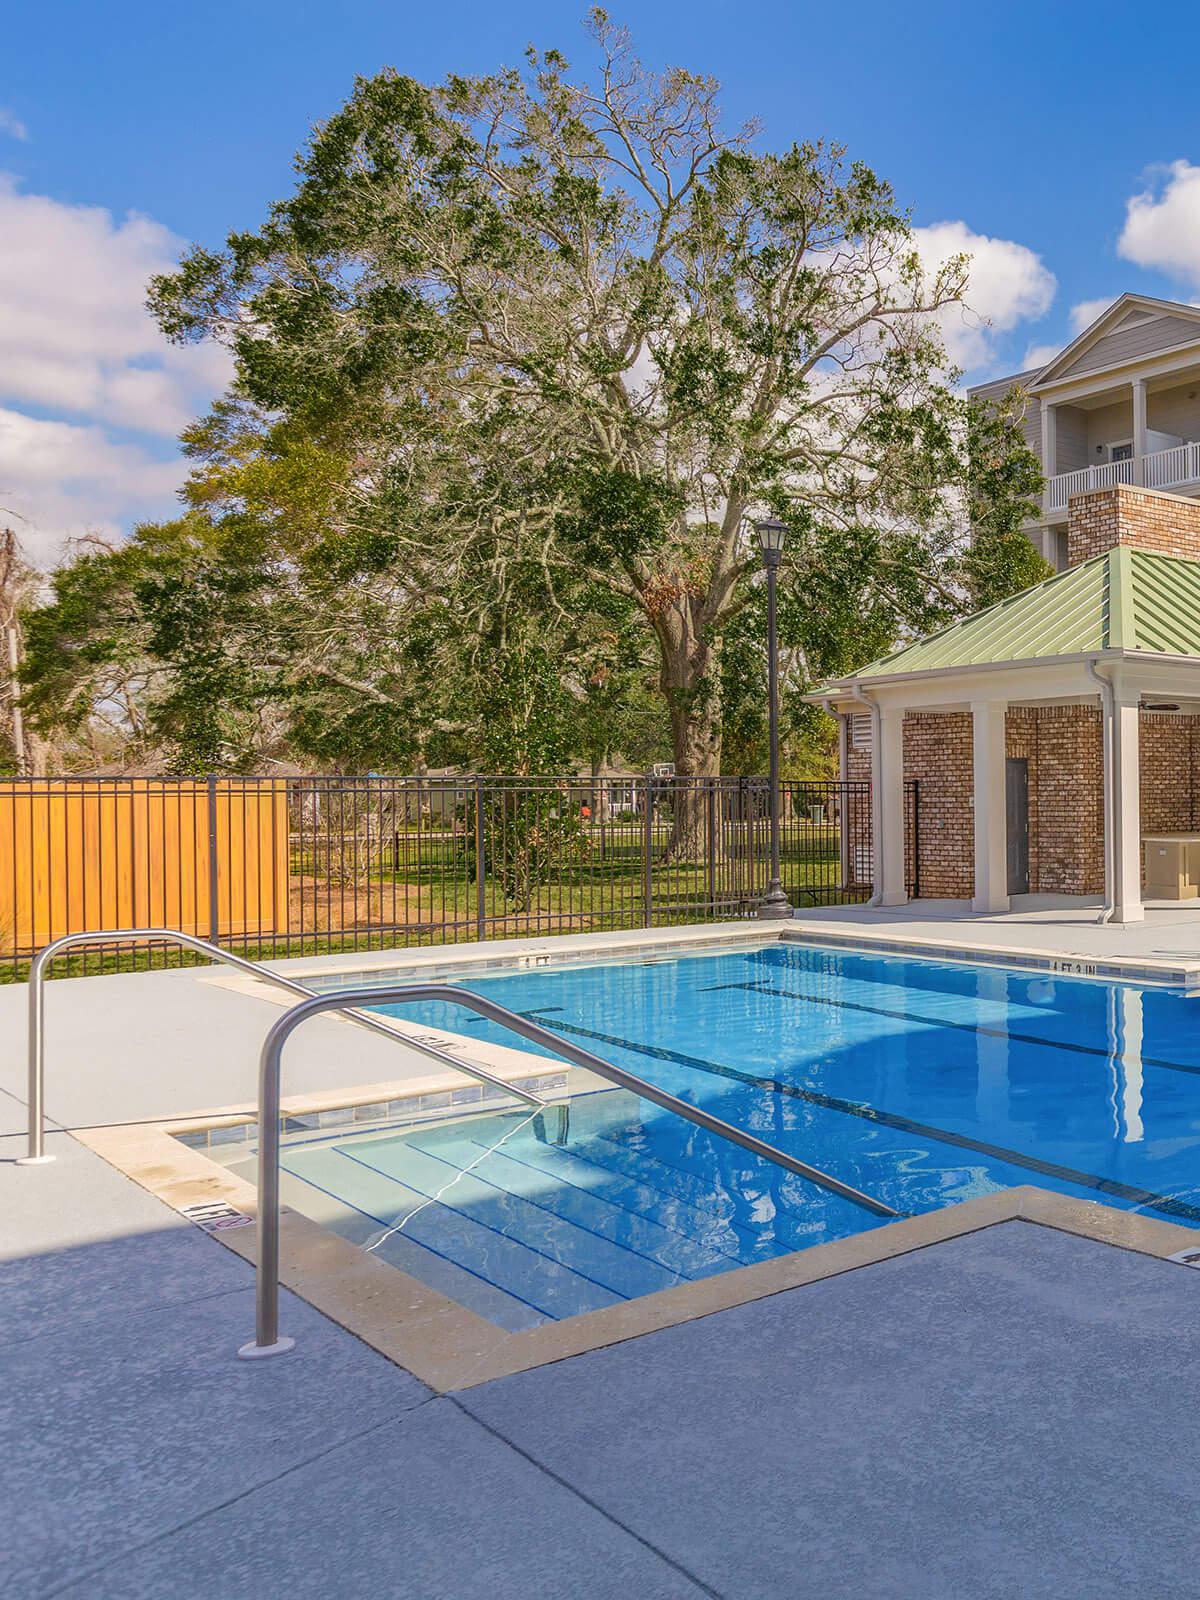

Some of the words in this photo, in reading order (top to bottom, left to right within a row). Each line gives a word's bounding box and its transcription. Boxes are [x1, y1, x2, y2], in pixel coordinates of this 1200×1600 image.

[1061, 962, 1072, 973] FT
[1085, 964, 1096, 976] IN
[190, 1208, 241, 1221] FT
